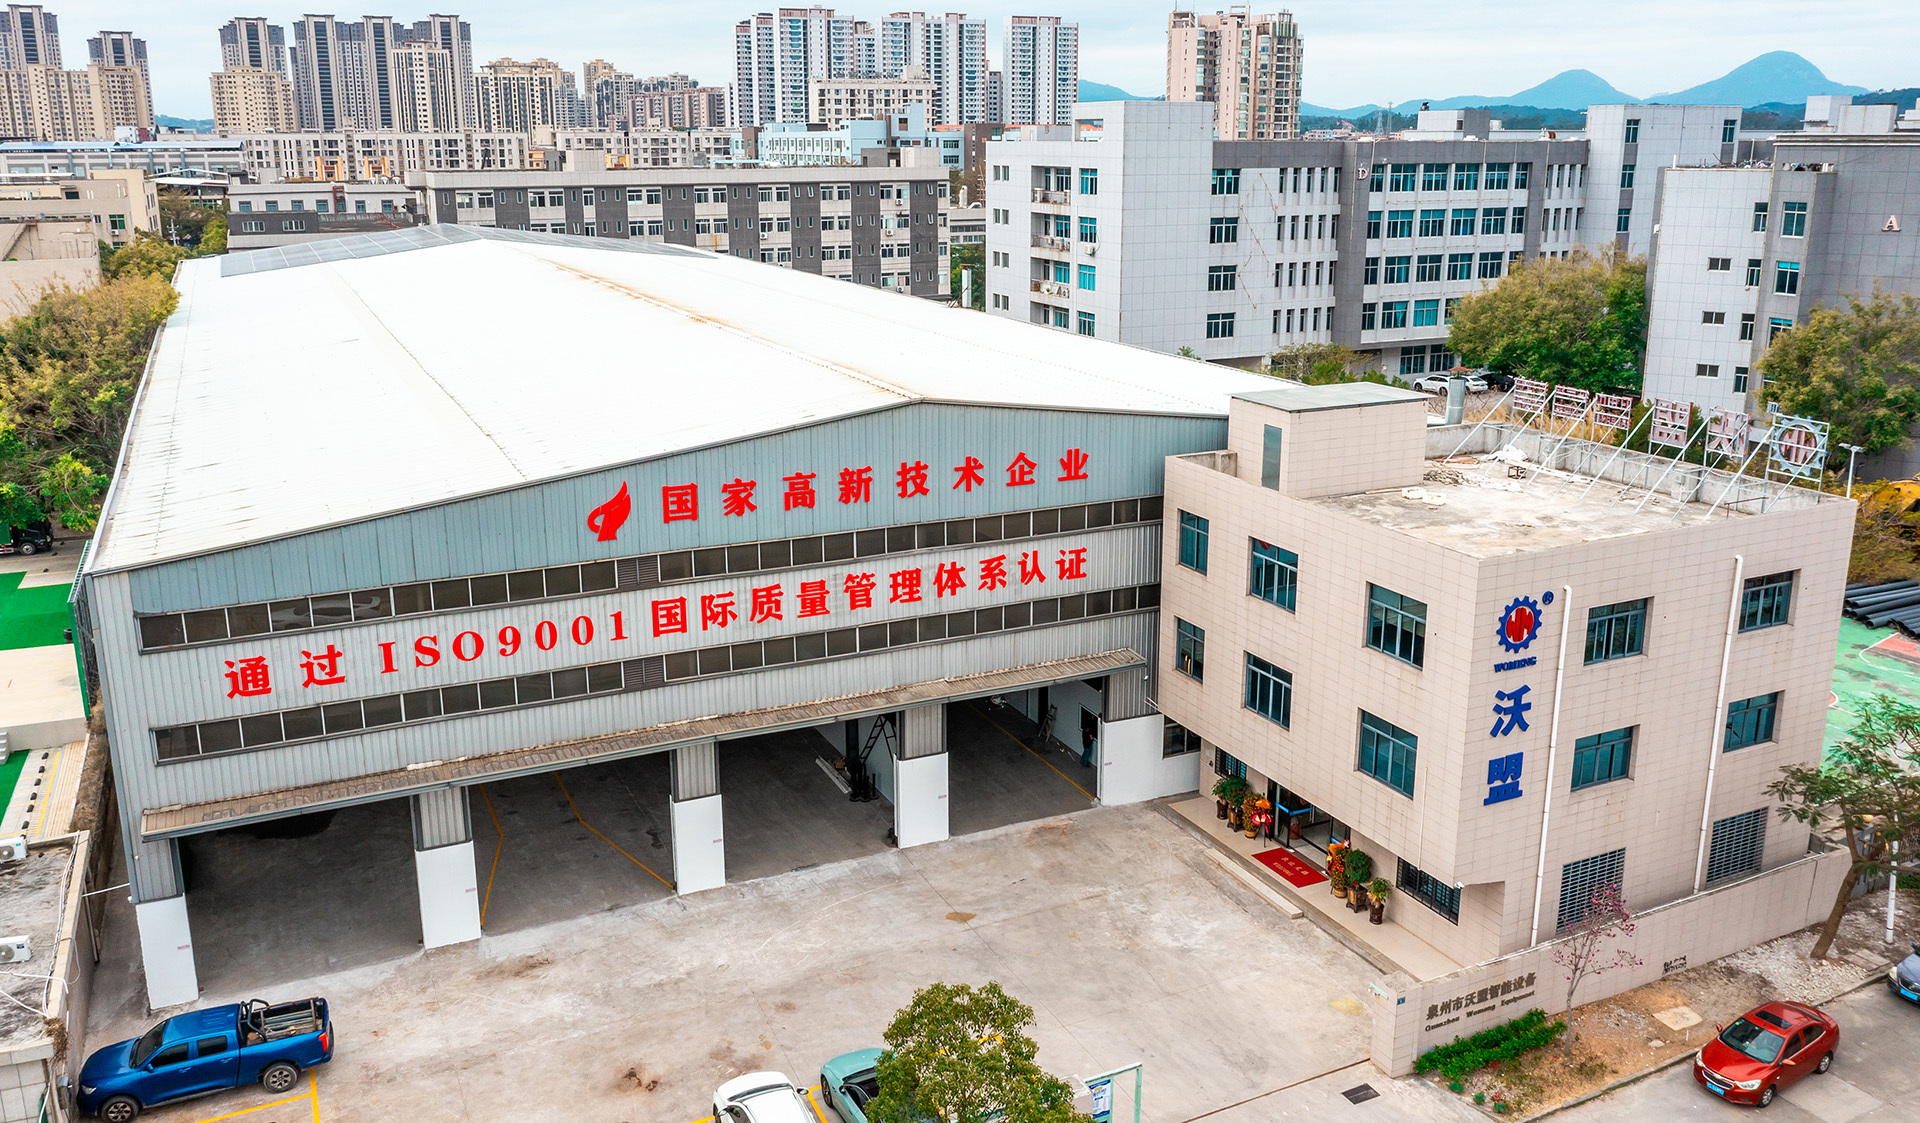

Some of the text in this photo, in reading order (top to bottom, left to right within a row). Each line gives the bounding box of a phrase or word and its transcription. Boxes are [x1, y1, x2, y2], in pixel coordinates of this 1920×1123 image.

[1358, 168, 1368, 180] D
[1881, 215, 1901, 232] A
[661, 448, 1090, 524] 国家高新技术企业
[224, 546, 1088, 700] 通过 ISO9001 国际质量管理体系认证
[1494, 656, 1537, 672] WOMENG
[1484, 684, 1532, 806] 沃盟
[1426, 972, 1537, 1020] 泉州市沃盟智能设备
